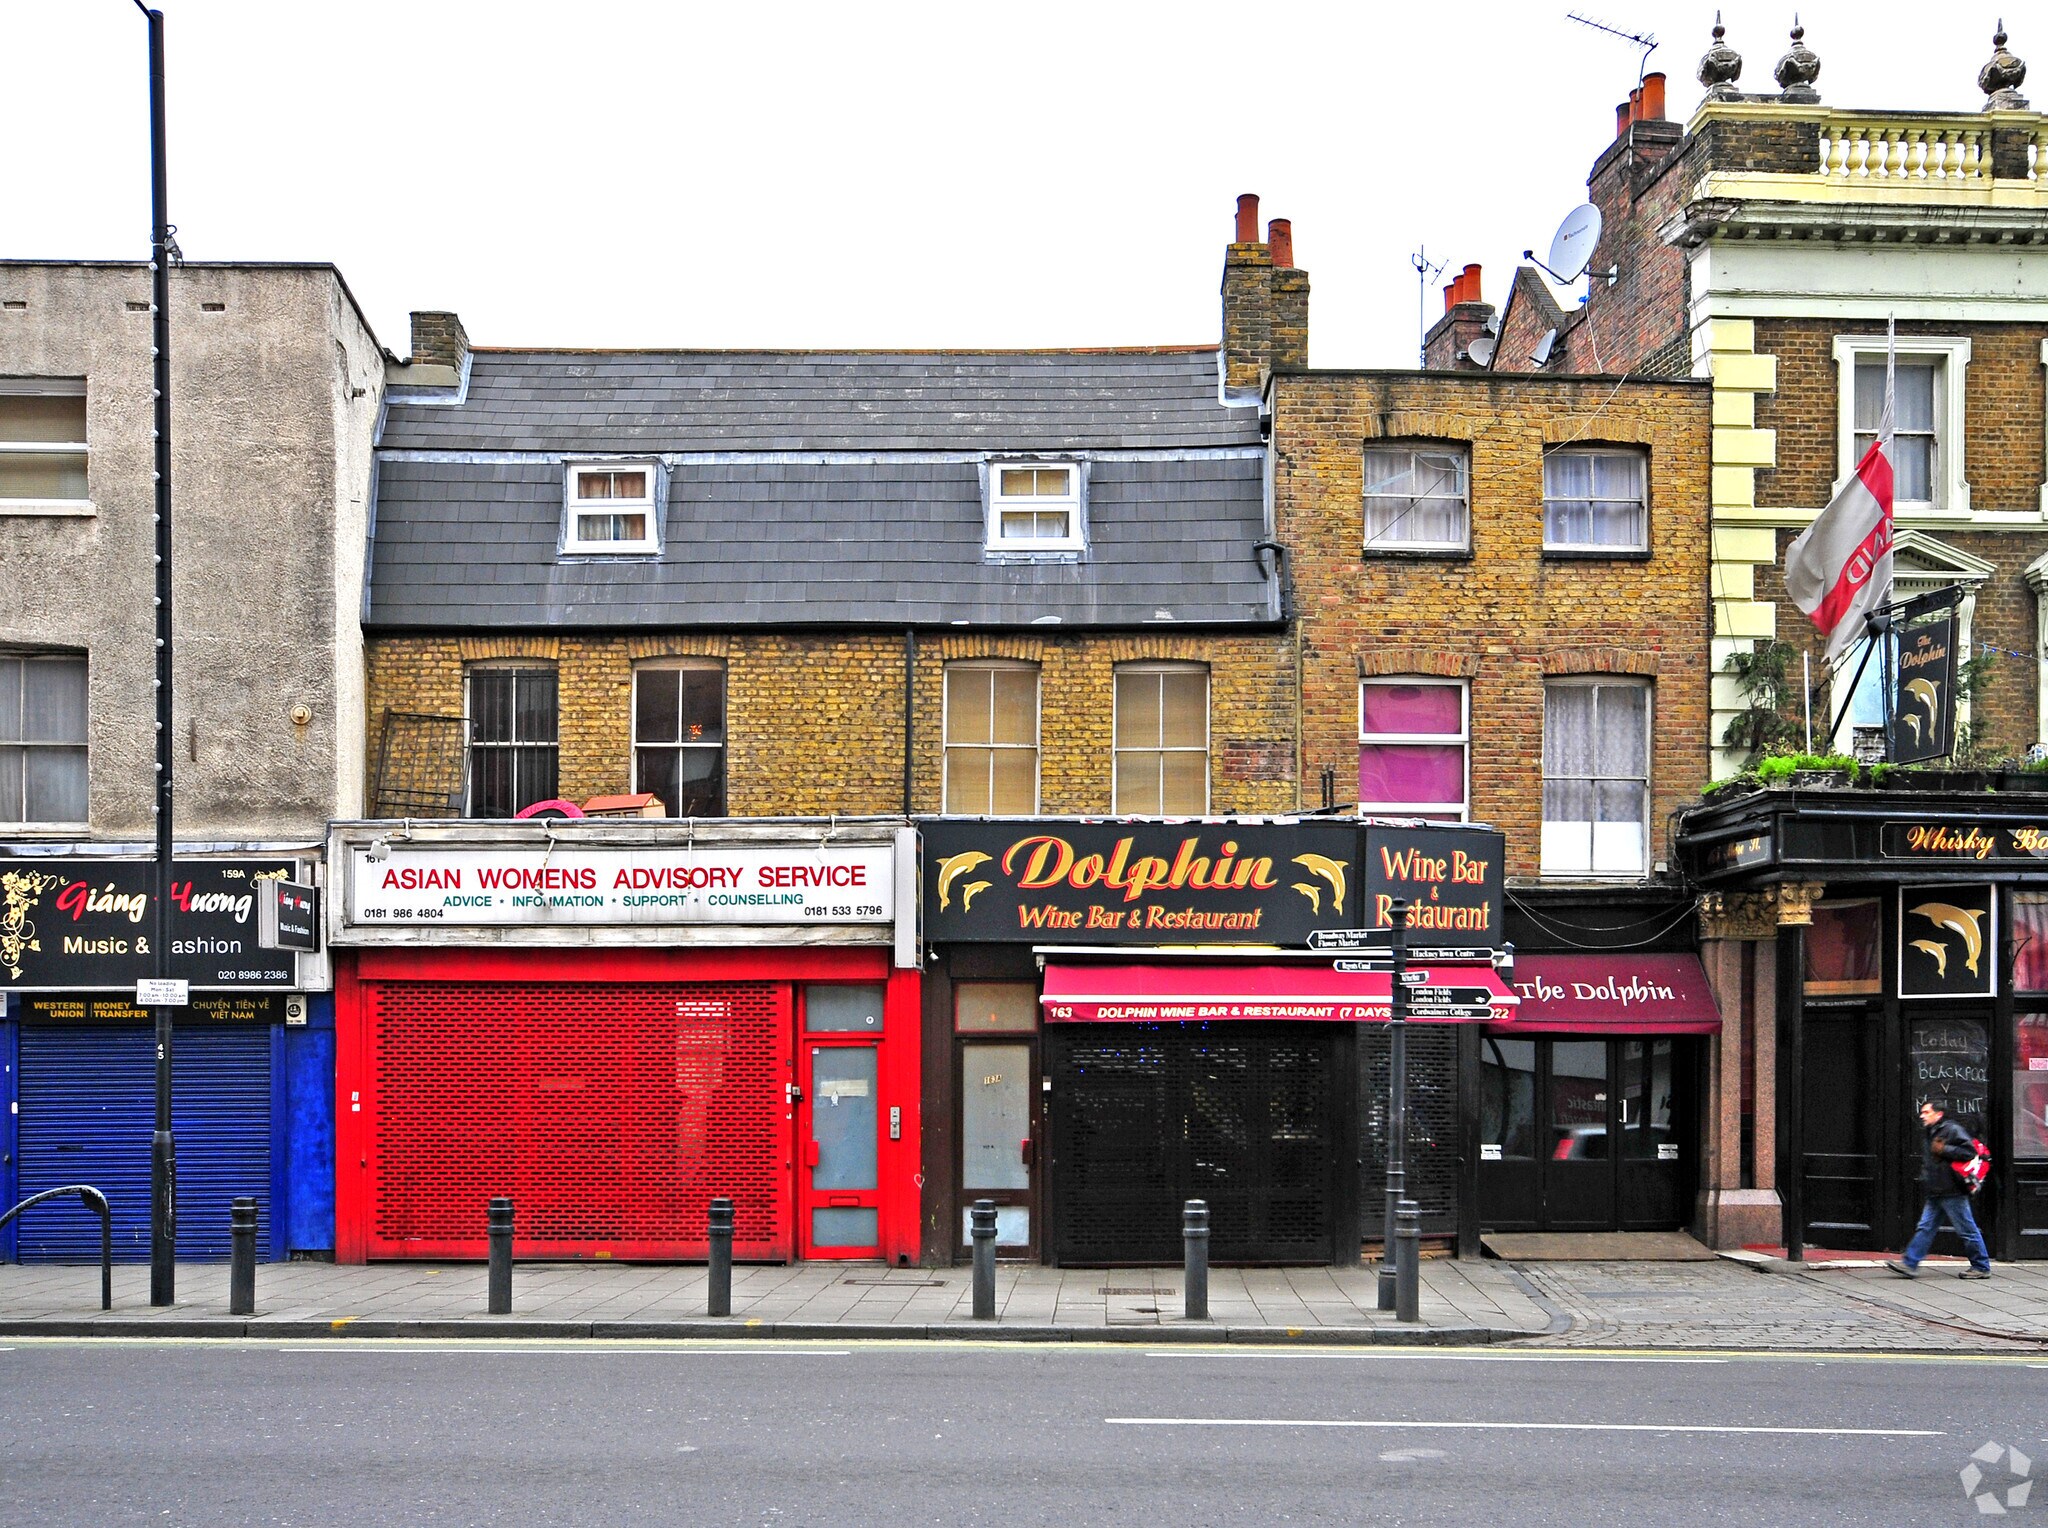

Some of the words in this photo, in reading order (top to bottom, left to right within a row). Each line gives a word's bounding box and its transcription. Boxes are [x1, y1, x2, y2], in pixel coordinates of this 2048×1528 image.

[1899, 643, 1947, 669] Dolphin
[1907, 825, 1995, 860] Whisky
[1001, 835, 1278, 902] Dolphin
[1380, 846, 1447, 882] Wine
[1451, 850, 1488, 884] Bar
[221, 869, 246, 878] 159A
[381, 868, 461, 890] ASIAN
[477, 868, 597, 890] WOMENS
[613, 866, 744, 889] ADVISORY
[758, 865, 867, 888] SERVICE
[1430, 885, 1439, 901] &
[56, 881, 147, 923] Giáng
[443, 896, 493, 907] ADVICE
[623, 895, 687, 907] SUPPORT
[708, 893, 804, 906] COUNSELLING
[364, 908, 387, 918] 0181
[393, 908, 413, 918] 986
[417, 908, 444, 918] 4804
[804, 906, 827, 916] 0181
[832, 906, 852, 916] 533
[856, 905, 883, 916] 5796
[1375, 894, 1491, 931] Rstaurant
[1017, 904, 1082, 928] Wine
[1085, 905, 1126, 928] Bar
[1127, 908, 1142, 928] &
[1145, 905, 1262, 930] Restaurant
[1346, 931, 1367, 939] Market
[63, 936, 128, 954] Music
[135, 936, 150, 954] &
[171, 936, 242, 954] ashion
[1338, 939, 1359, 947] Market
[1412, 950, 1438, 959] Hackney
[218, 970, 236, 980] 020
[238, 970, 262, 980] 8986
[264, 970, 288, 980] 2386
[1411, 987, 1433, 995] London
[1513, 975, 1565, 1002] The
[1571, 975, 1675, 1006] Dolphin
[34, 1002, 84, 1010] WESTERN
[93, 1002, 131, 1010] MONEY
[50, 1010, 84, 1018] UNION
[93, 1010, 148, 1018] TRANSFER
[231, 1011, 255, 1019] NAM
[1050, 1007, 1072, 1017] 163
[1097, 1007, 1157, 1018] DOLPHIN
[1160, 1007, 1195, 1017] WINE
[1197, 1006, 1228, 1017] BAR
[1230, 1007, 1241, 1016] &
[1243, 1006, 1334, 1017] RESTAURANT
[1339, 1007, 1353, 1019] (7
[1355, 1007, 1392, 1019] DAYS
[1449, 1008, 1472, 1017] College
[1914, 1029, 1967, 1051] Today
